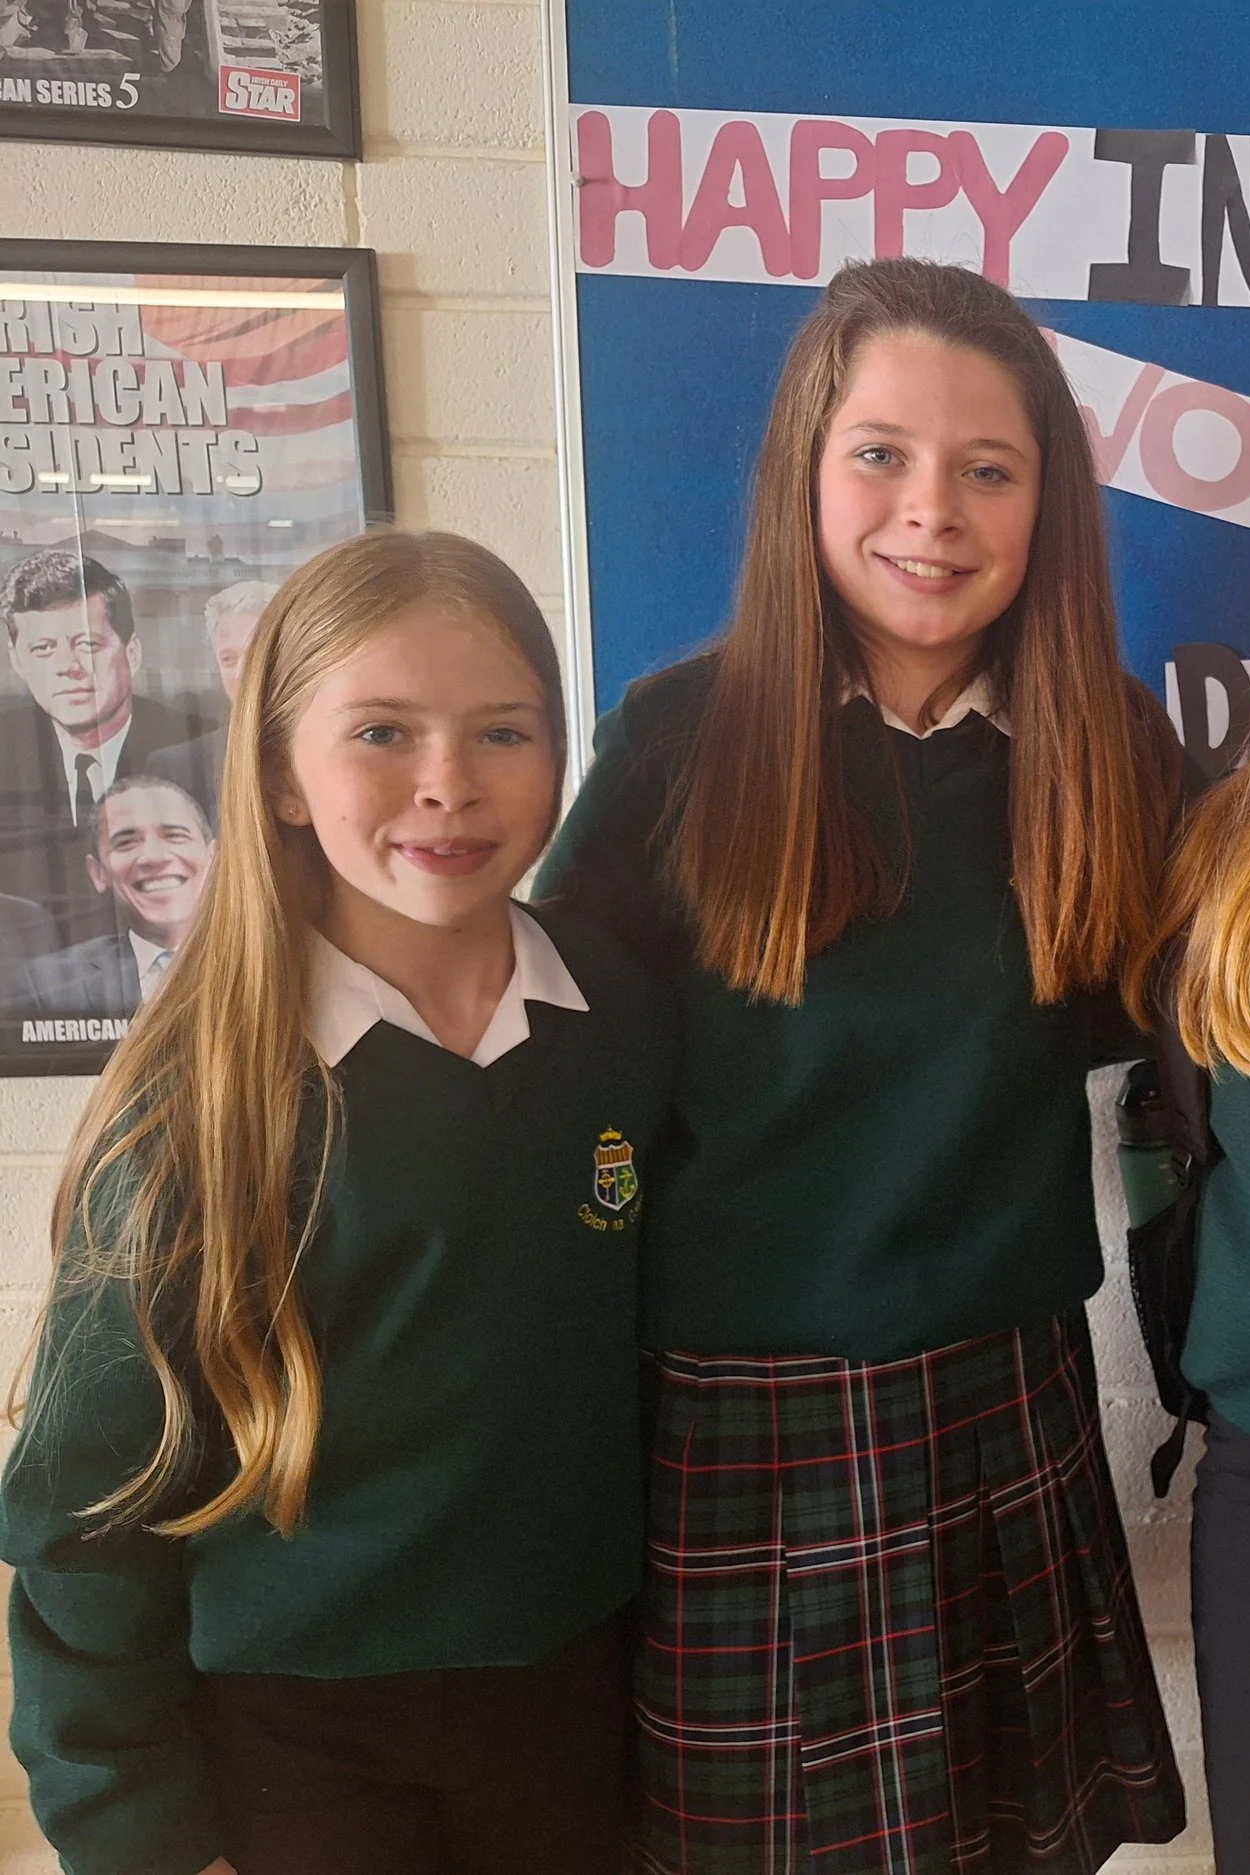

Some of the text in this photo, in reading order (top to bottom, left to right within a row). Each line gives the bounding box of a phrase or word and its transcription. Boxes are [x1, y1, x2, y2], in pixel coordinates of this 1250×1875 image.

[0, 72, 141, 109] AN SERIES 5
[225, 71, 295, 115] STAR
[251, 76, 269, 86] IRISH
[576, 109, 1070, 288] HAPPY
[0, 428, 263, 496] SIDENTS
[22, 1018, 129, 1043] AMERICAN
